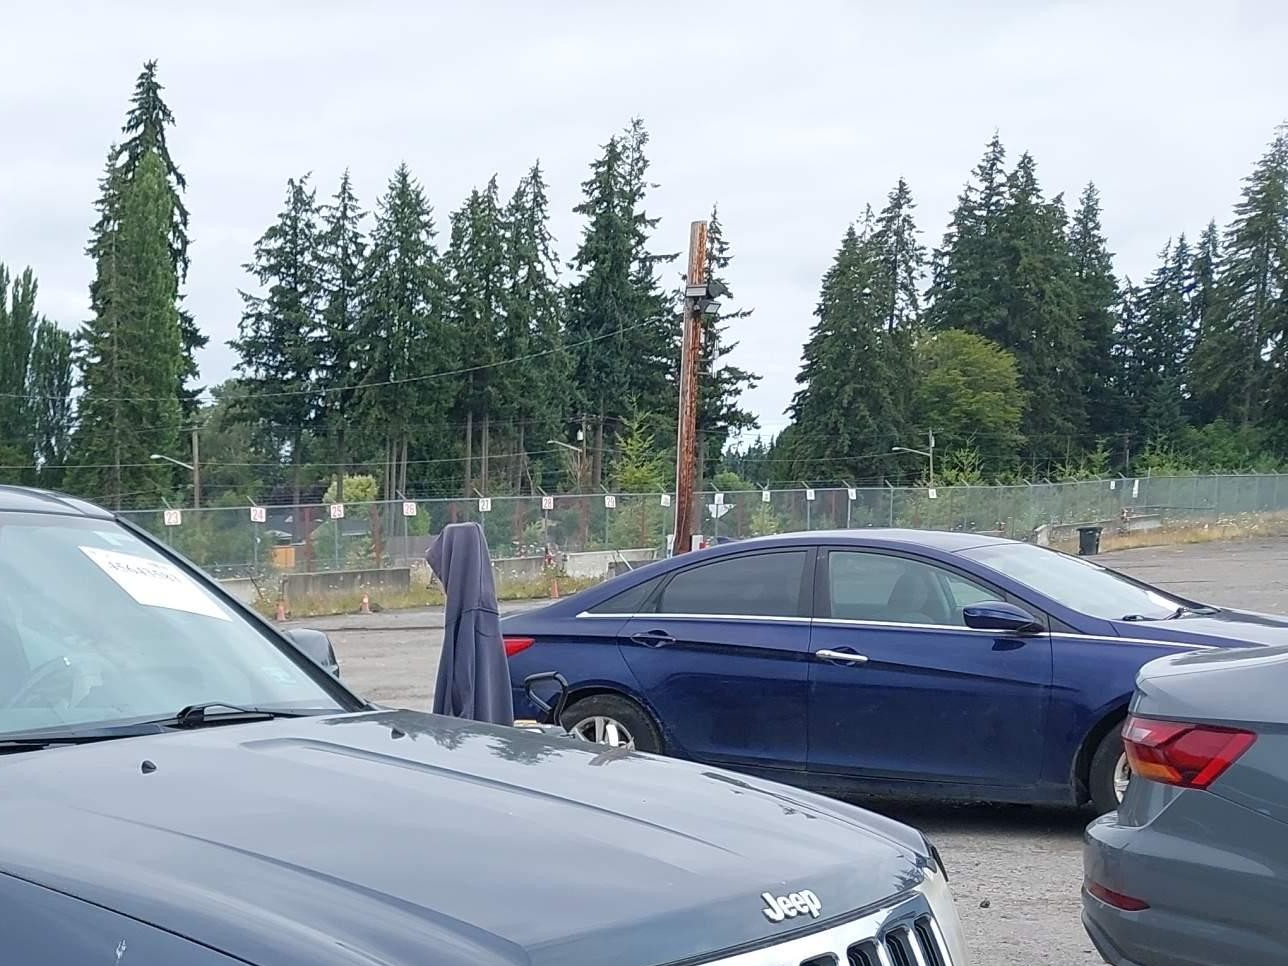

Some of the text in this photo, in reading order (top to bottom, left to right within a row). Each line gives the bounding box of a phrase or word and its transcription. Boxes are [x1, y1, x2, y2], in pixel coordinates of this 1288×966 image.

[480, 499, 490, 510] 27
[543, 497, 552, 508] 28
[252, 508, 264, 520] 24
[332, 505, 342, 517] 25
[404, 504, 415, 514] 26
[166, 511, 178, 523] 23
[761, 889, 822, 922] Jeep
